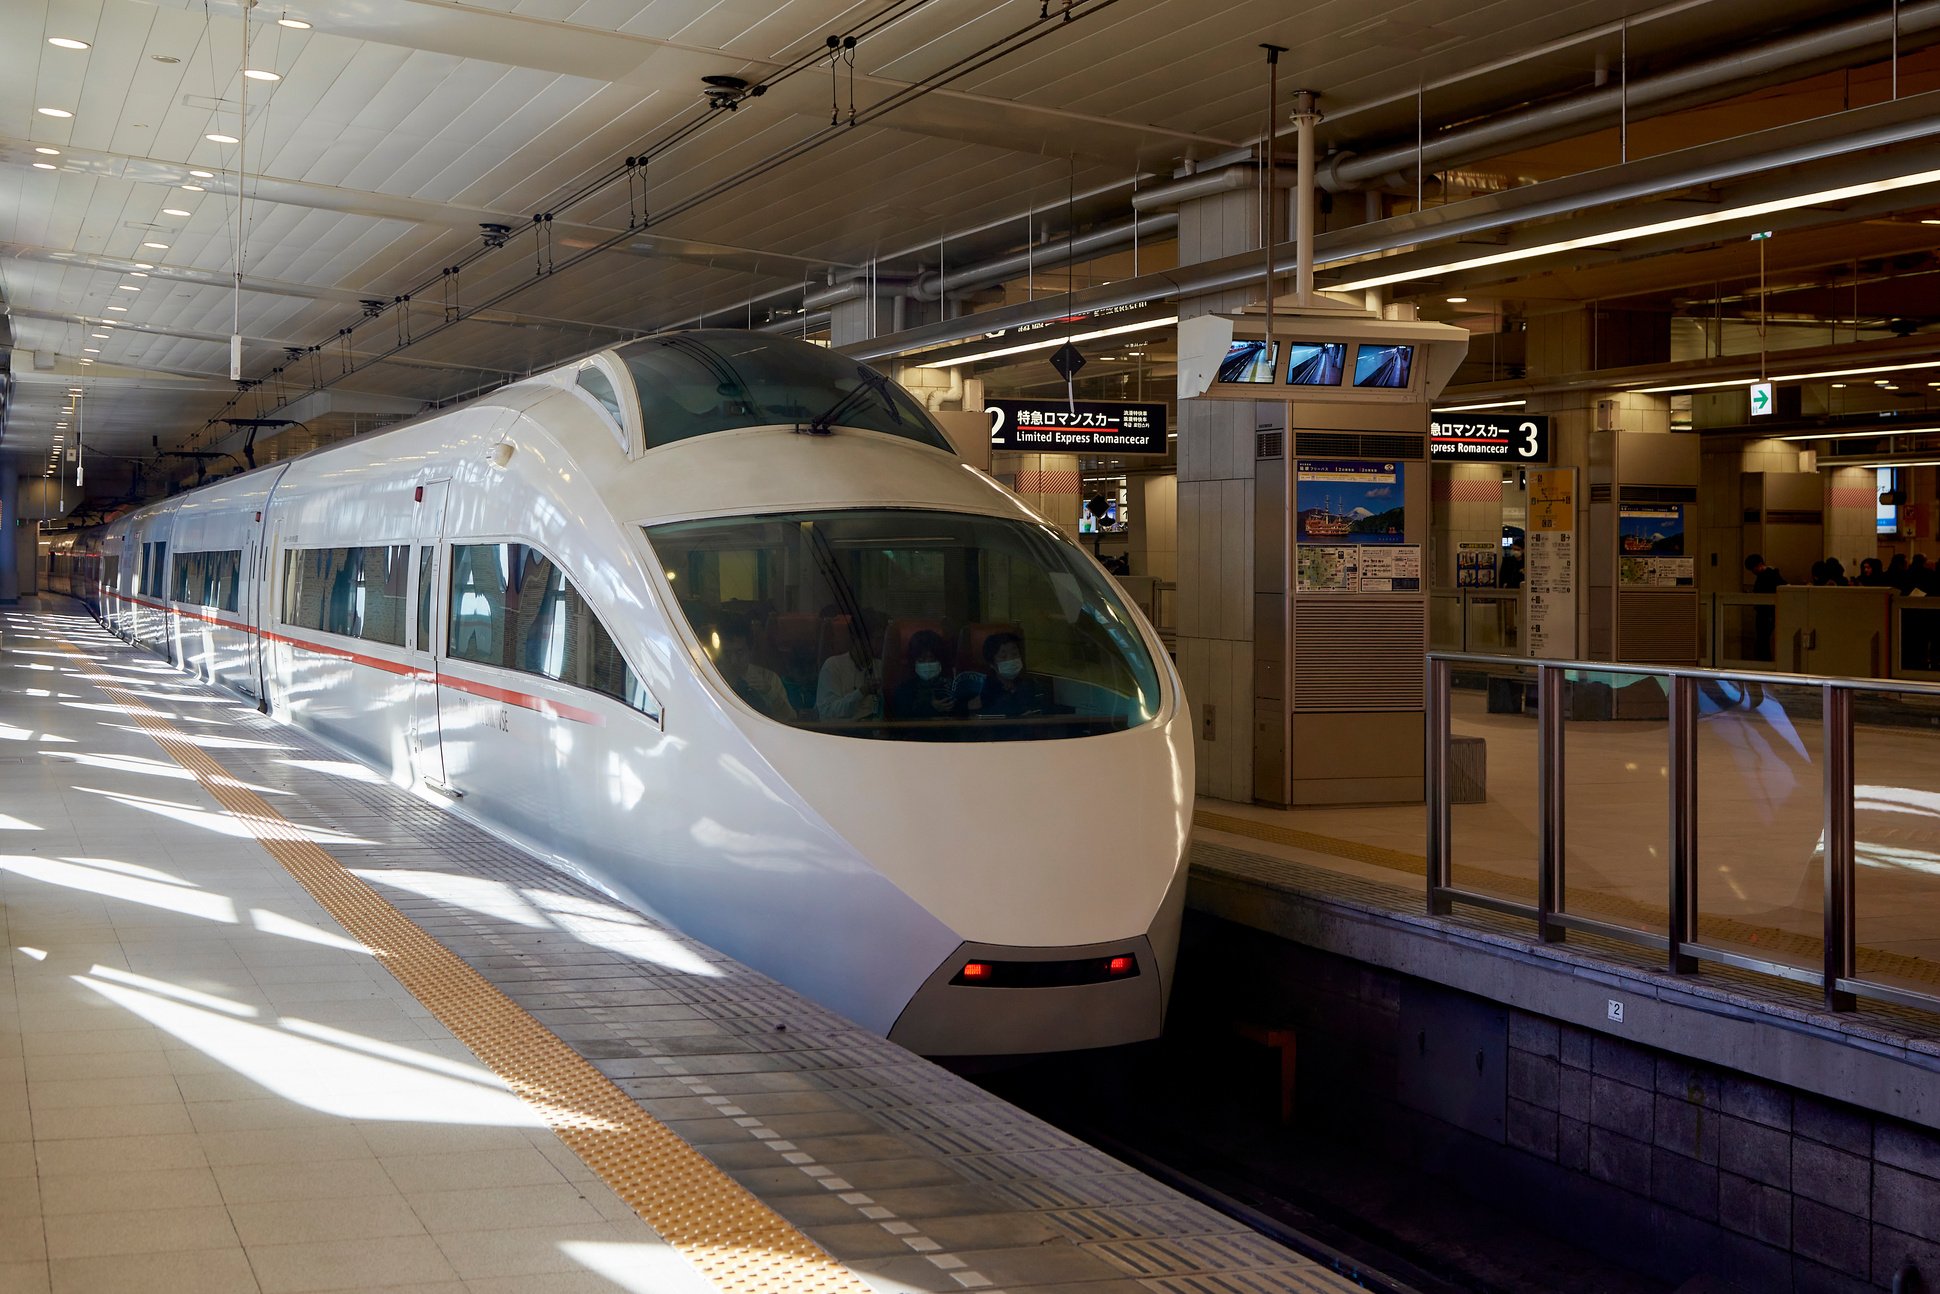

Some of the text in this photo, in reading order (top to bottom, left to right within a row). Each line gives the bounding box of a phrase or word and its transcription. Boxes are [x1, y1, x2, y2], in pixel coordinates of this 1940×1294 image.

[984, 406, 1005, 444] 2
[1017, 409, 1120, 427] 特急ロマンスカー
[1016, 430, 1150, 446] Limited Express Romancecar
[1517, 421, 1539, 458] 3
[1457, 442, 1509, 454] Romancecar
[1613, 1003, 1620, 1016] 2
